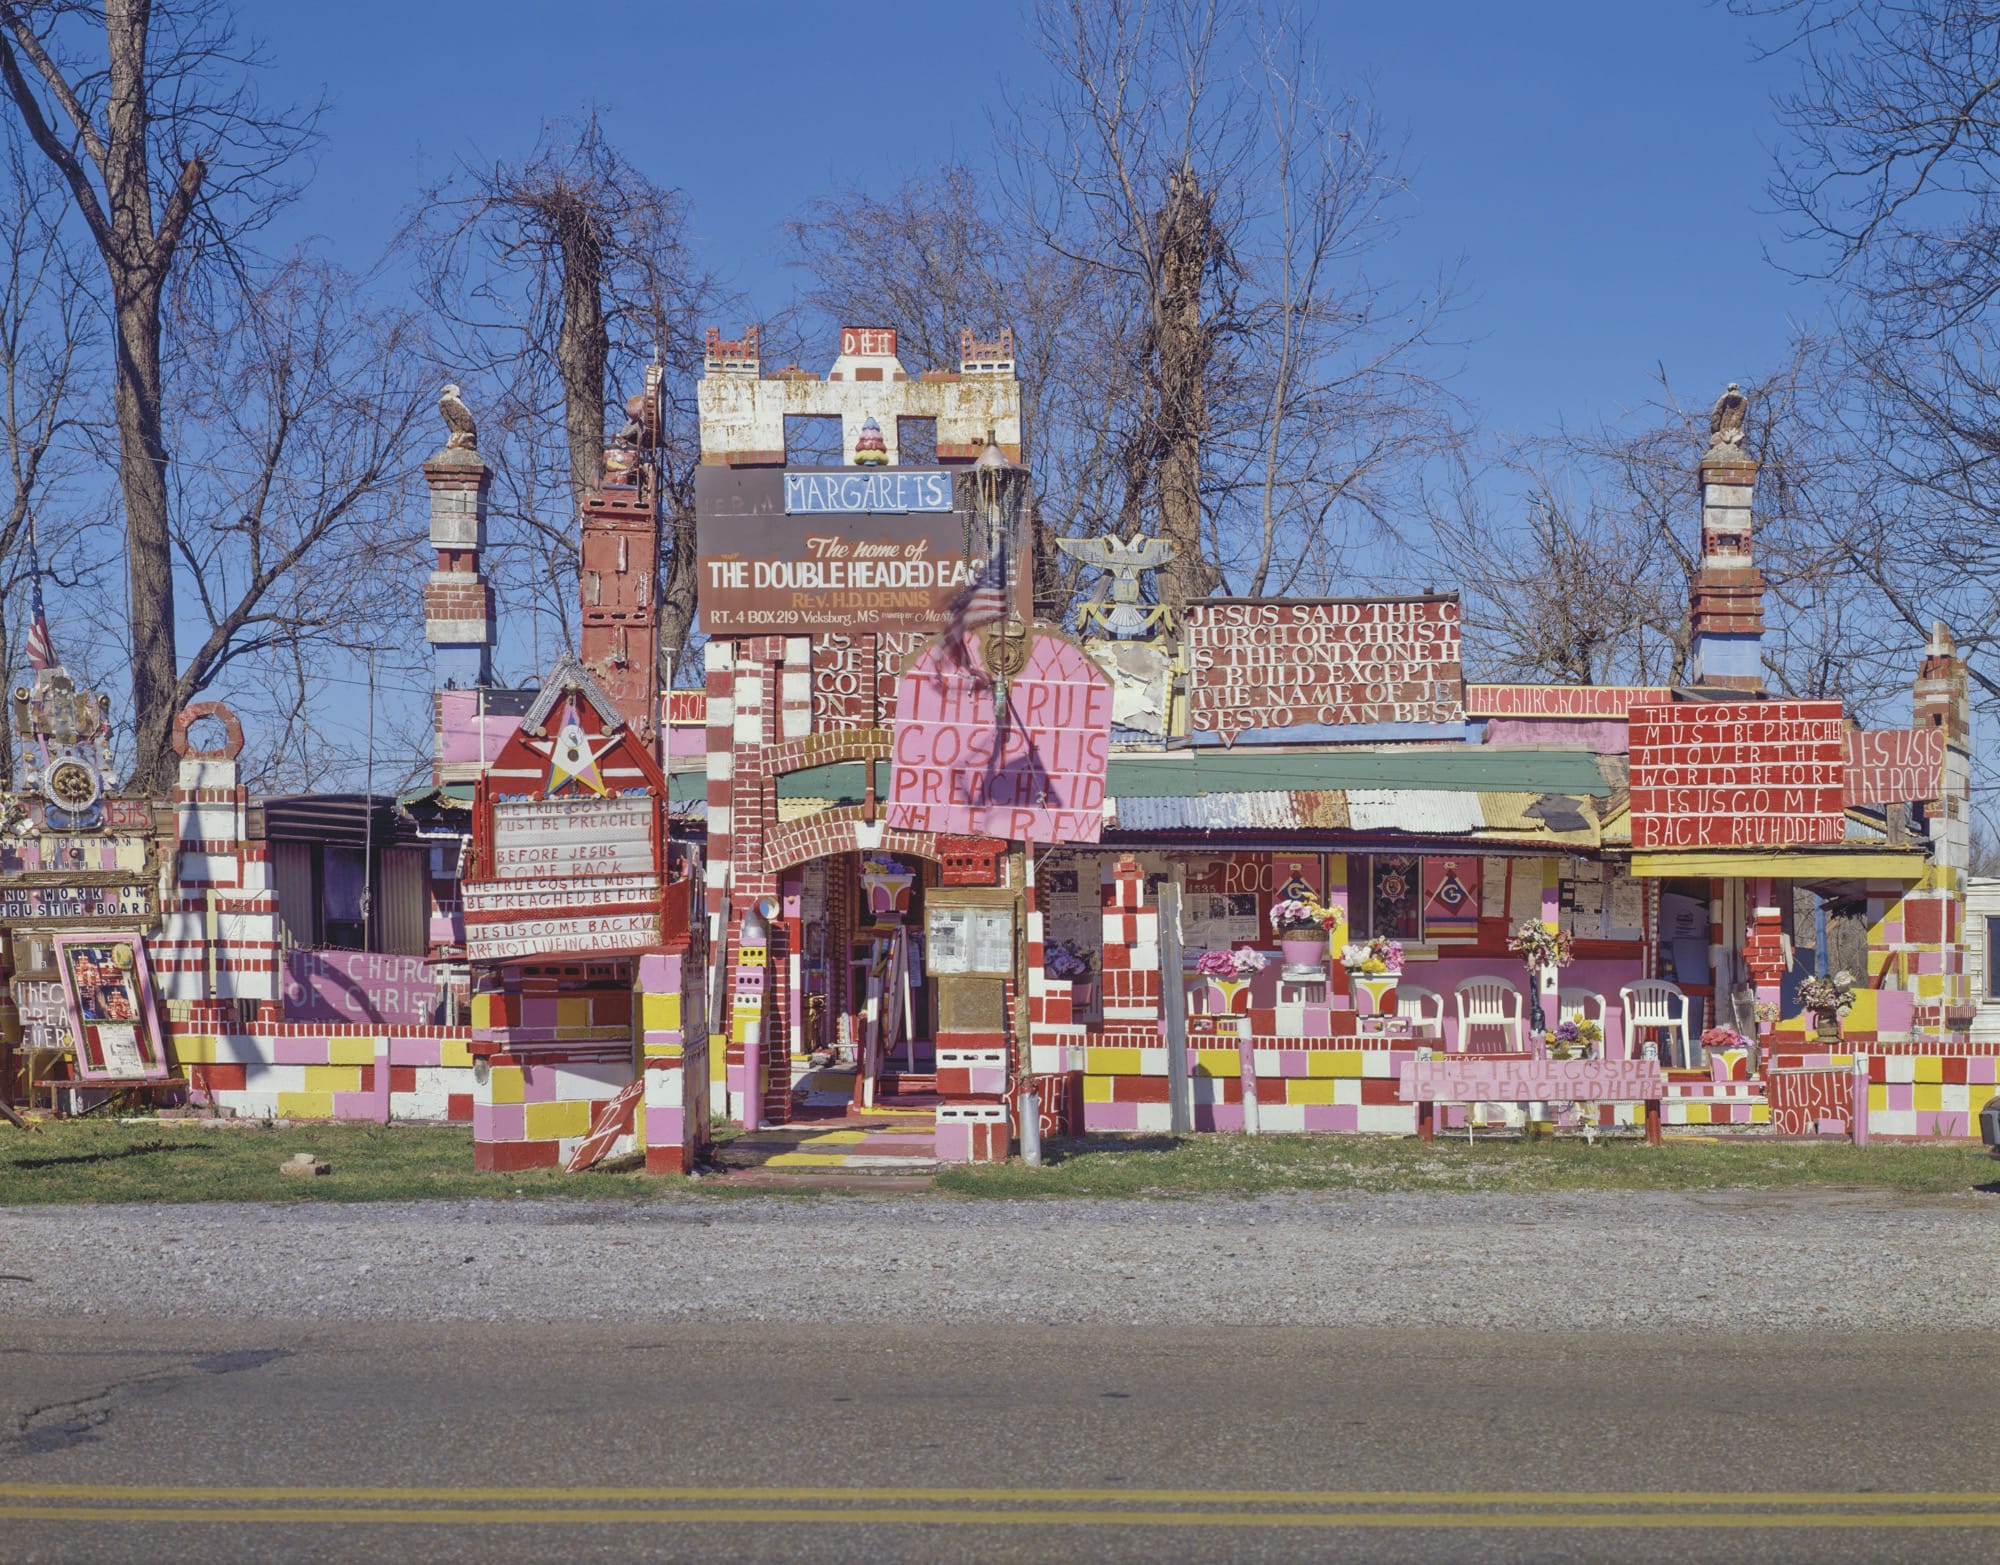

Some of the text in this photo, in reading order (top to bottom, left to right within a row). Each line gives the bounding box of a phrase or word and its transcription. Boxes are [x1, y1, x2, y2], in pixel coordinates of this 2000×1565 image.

[786, 475, 943, 509] MARGARETS
[806, 536, 928, 563] The home of
[708, 558, 1018, 589] THE DOUBLE HEADED EAGE
[792, 592, 829, 609] REV.
[868, 591, 931, 608] DENNIS
[710, 610, 734, 624] RT.
[735, 610, 745, 623] 4
[748, 611, 775, 624] BOX
[776, 611, 799, 624] 219
[857, 610, 880, 624] MS
[1189, 604, 1280, 628] JESUS
[1292, 603, 1361, 626] SAID
[1366, 602, 1425, 625] THE
[1188, 622, 1460, 648] HURCH OF CHRIST
[1190, 648, 1215, 671] IS
[1223, 646, 1288, 668] THE
[1291, 643, 1362, 666] ONLY
[1371, 641, 1433, 664] ONE
[1190, 662, 1441, 689] E BUILD EXCEPT
[906, 673, 993, 726] THE
[1191, 687, 1252, 710] THE
[1266, 684, 1354, 707] NAME
[1366, 682, 1404, 704] OF
[1317, 704, 1381, 726] CAN
[1645, 704, 1806, 724] THE GOSPEL
[1645, 720, 1844, 746] MUST BE PREACHED
[897, 724, 1068, 773] GOSPEL
[1641, 744, 1822, 767] ALL OVER THE
[1641, 767, 1736, 786] WORLD
[1889, 766, 1943, 803] ROCK
[1644, 787, 1826, 815] JESUS COME
[541, 817, 560, 831] BE
[60, 836, 131, 849] SOLOMON
[31, 860, 119, 870] TEMPLE
[496, 844, 618, 864] BEFORE JESUS
[6, 887, 144, 901] NO WORK ON
[466, 895, 486, 910] BE
[97, 902, 151, 915] BOARD
[472, 925, 527, 940] JESUS
[530, 920, 579, 935] COME
[1412, 1059, 1662, 1081] THE TRUE GOSPEL
[1412, 1079, 1664, 1101] IS PREACHED HERE
